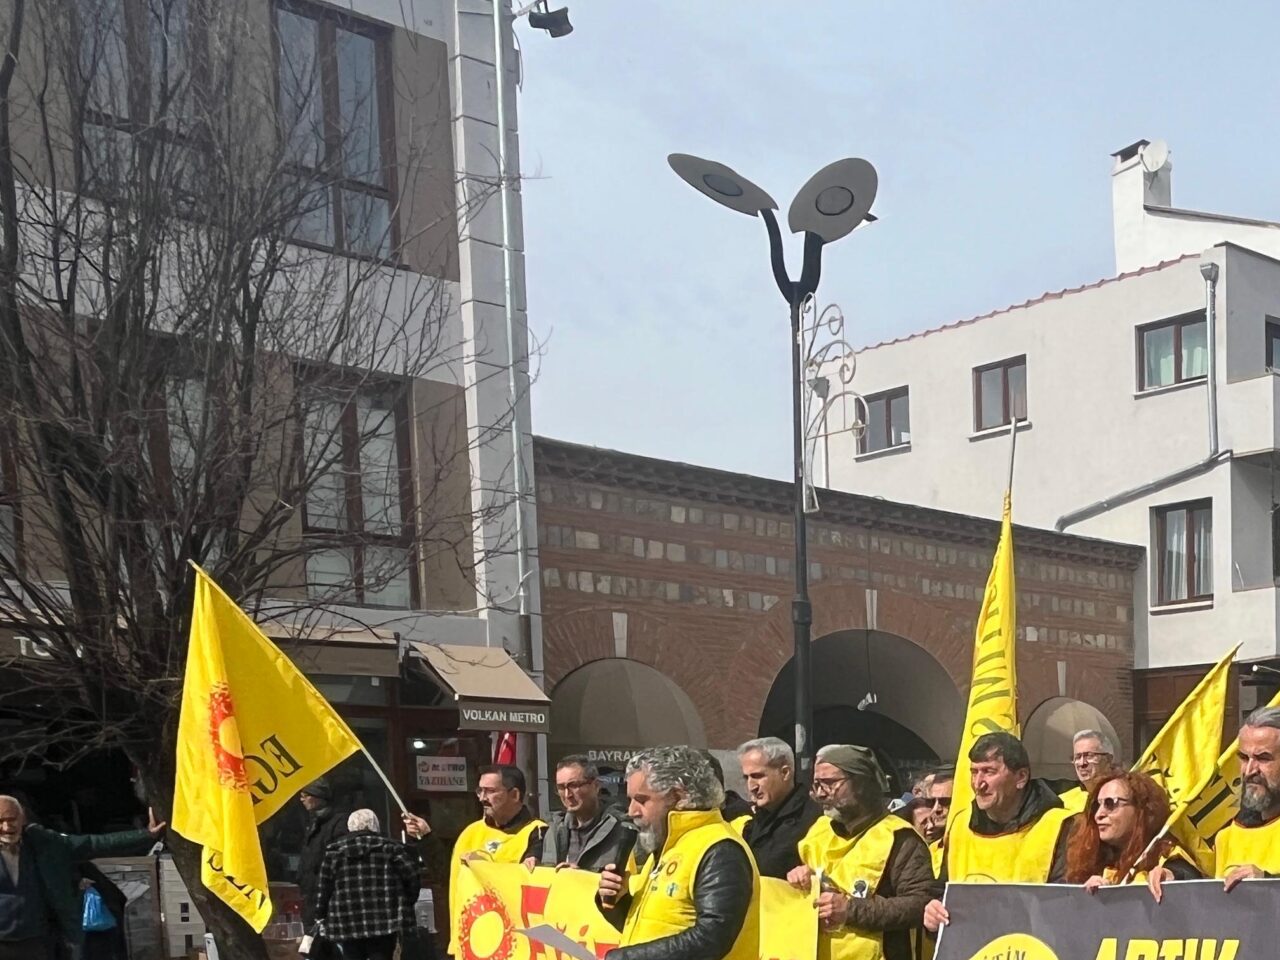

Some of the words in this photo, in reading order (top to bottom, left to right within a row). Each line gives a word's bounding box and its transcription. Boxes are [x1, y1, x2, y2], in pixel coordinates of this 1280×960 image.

[463, 709, 506, 722] VOLKAN
[509, 711, 545, 724] METRO
[588, 750, 634, 761] BAYRA
